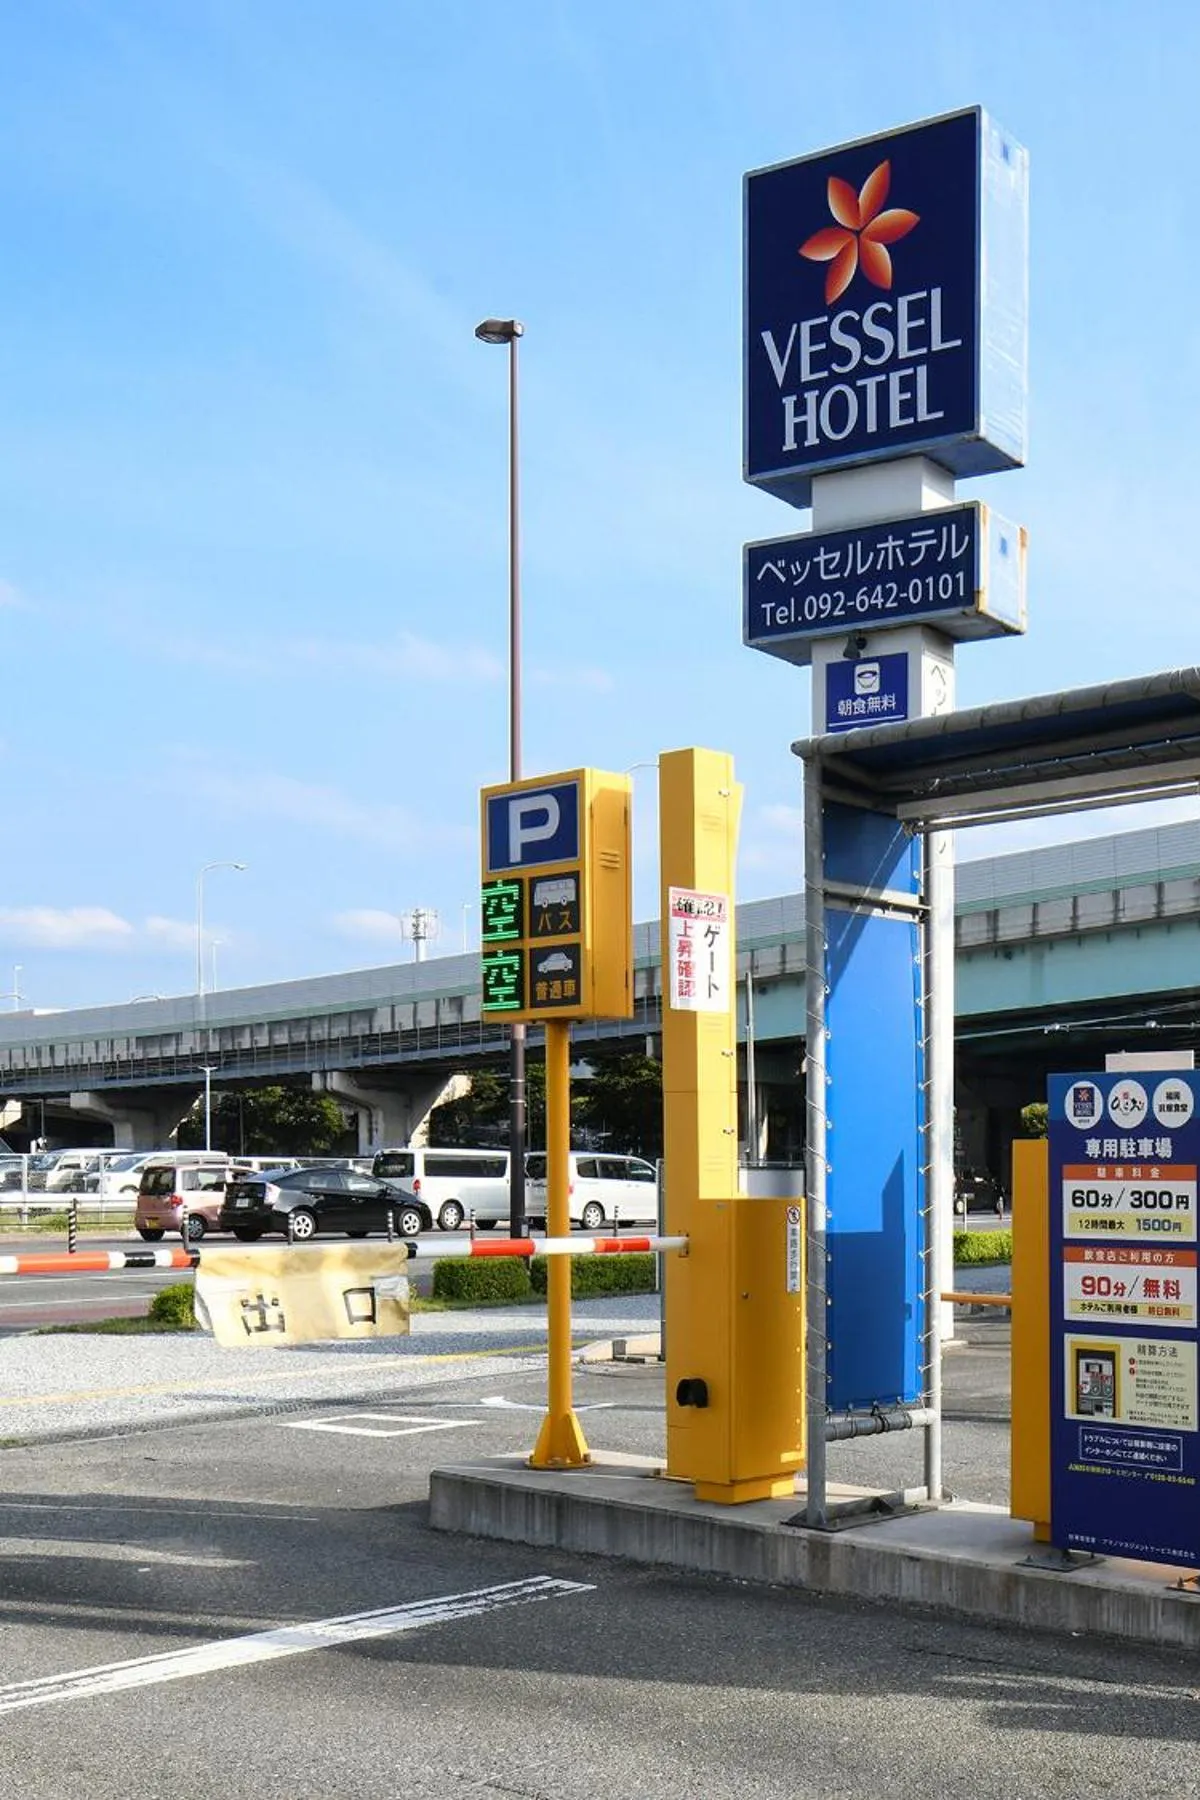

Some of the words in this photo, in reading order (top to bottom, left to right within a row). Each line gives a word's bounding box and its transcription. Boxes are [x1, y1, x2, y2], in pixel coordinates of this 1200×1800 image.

[761, 287, 962, 388] VESSEL
[781, 364, 944, 452] HOTEL
[757, 524, 969, 586] ベッセルホテル
[761, 571, 965, 627] Tel.092-642-0101
[837, 693, 897, 716] 朝食無料
[509, 795, 560, 863] P
[481, 879, 519, 942] 空
[538, 911, 573, 930] バス
[481, 950, 520, 1010] 空
[535, 978, 577, 1000] 普通車
[704, 924, 720, 999] ゲート
[1085, 1137, 1172, 1158] 専用駐車場
[1136, 1218, 1182, 1233] 1500円
[241, 1286, 376, 1336] 出口
